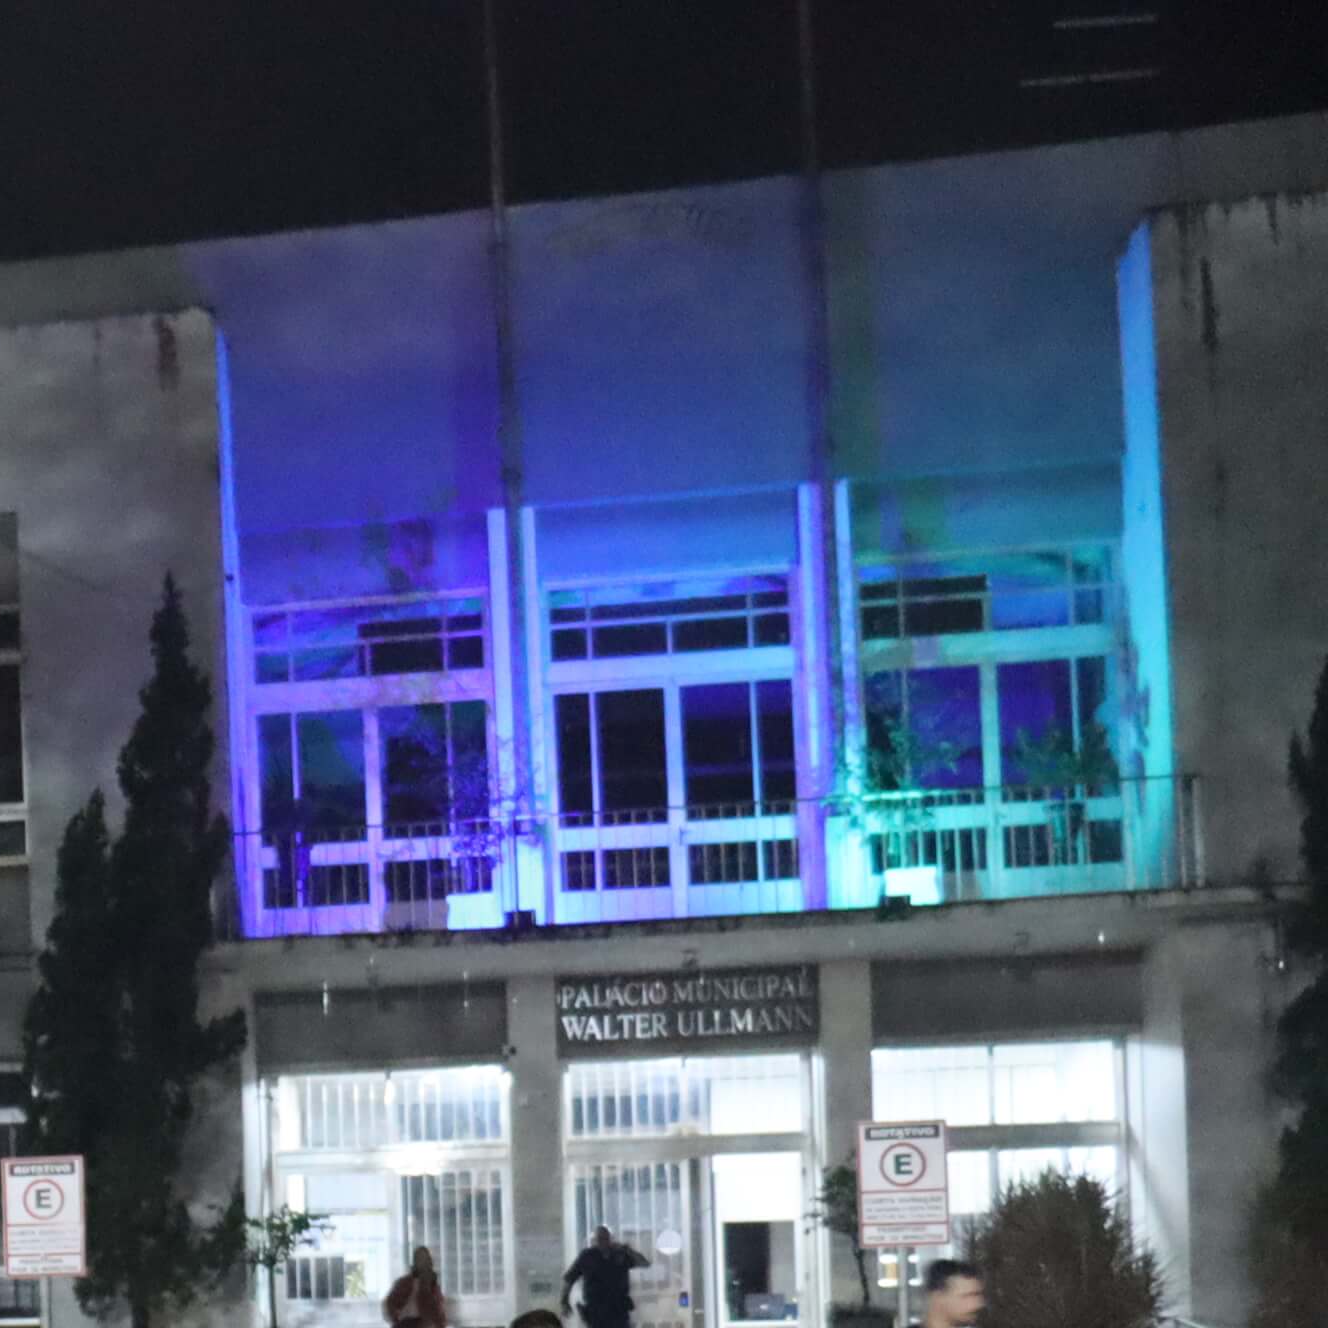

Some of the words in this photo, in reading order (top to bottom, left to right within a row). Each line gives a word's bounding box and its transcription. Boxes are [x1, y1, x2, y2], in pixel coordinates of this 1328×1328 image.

[672, 975, 815, 1003] MUNICIPAL
[560, 1012, 669, 1041] WALTER
[676, 1006, 815, 1037] ULLMANN
[894, 1153, 912, 1175] E
[35, 1188, 52, 1209] E
